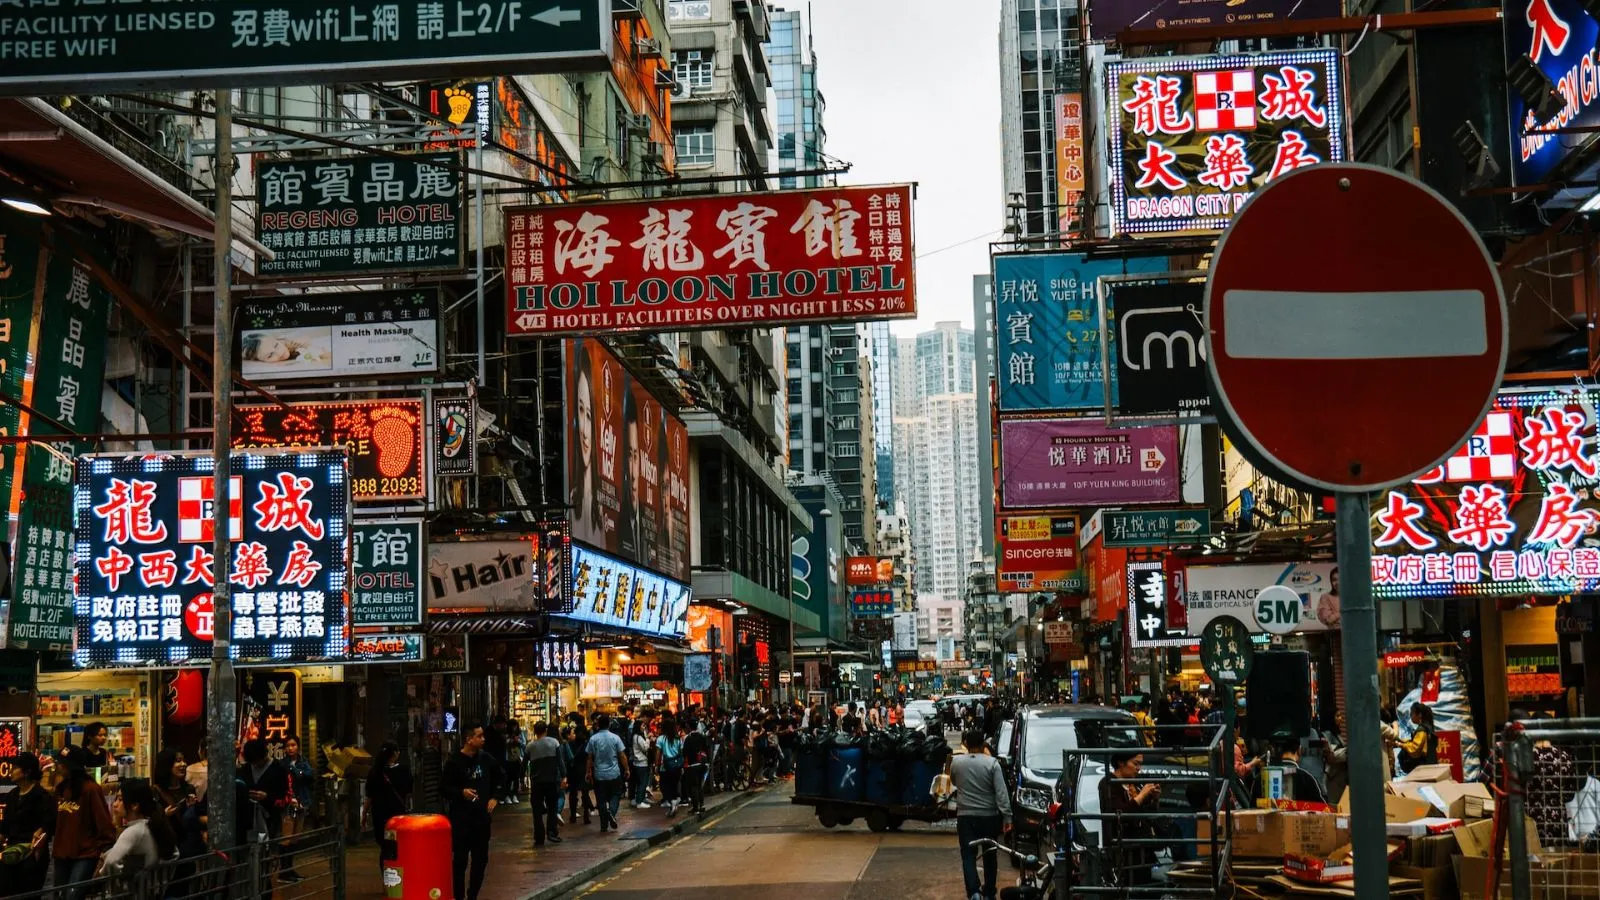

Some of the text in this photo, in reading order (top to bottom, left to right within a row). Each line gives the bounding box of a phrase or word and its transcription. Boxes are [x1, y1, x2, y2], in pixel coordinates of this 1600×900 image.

[1, 12, 215, 35] FACILITY LIENSED
[231, 2, 522, 47] 免費wifi上網 請上2/F
[2, 38, 116, 58] FREE WIFI
[1259, 66, 1327, 127] 城
[1122, 75, 1194, 136] 龍
[1129, 195, 1192, 219] DRAGON
[1199, 193, 1231, 215] CITY
[261, 203, 456, 230] REGENG HOTEL
[553, 198, 864, 278] 海龍賓館
[287, 249, 318, 259] FACILITY
[319, 248, 350, 258] LIENSED
[261, 259, 321, 270] HOTEL FREE WIFI
[513, 264, 905, 312] HOI LOON HOTEL
[1050, 278, 1077, 289] SING
[1050, 290, 1077, 301] YUET
[295, 301, 344, 316] Massage
[553, 296, 905, 328] HOTEL FACILITEIS OVER NIGHT LESS 20%
[341, 327, 414, 338] Health Massage
[415, 353, 432, 362] 1/F
[1097, 370, 1116, 378] KG
[1519, 407, 1596, 478] 城
[380, 477, 417, 492] 2093
[1073, 478, 1166, 489] 10/F YUEN KING BUILDING
[94, 479, 167, 543] 龍
[253, 472, 324, 540] 城
[1005, 547, 1055, 559] sincere
[452, 549, 527, 593] Hair
[353, 571, 415, 589] OTEL
[385, 605, 414, 613] LIENSED
[1214, 601, 1242, 609] OPTICAL
[1257, 600, 1299, 624] 5M
[391, 612, 413, 620] WIFI
[14, 622, 39, 638] HOTEL
[40, 623, 59, 639] FREE
[1215, 624, 1233, 638] 5M
[353, 640, 405, 652] SSAGE
[618, 664, 659, 677] ONJOUR
[1180, 769, 1210, 777] SPOR
